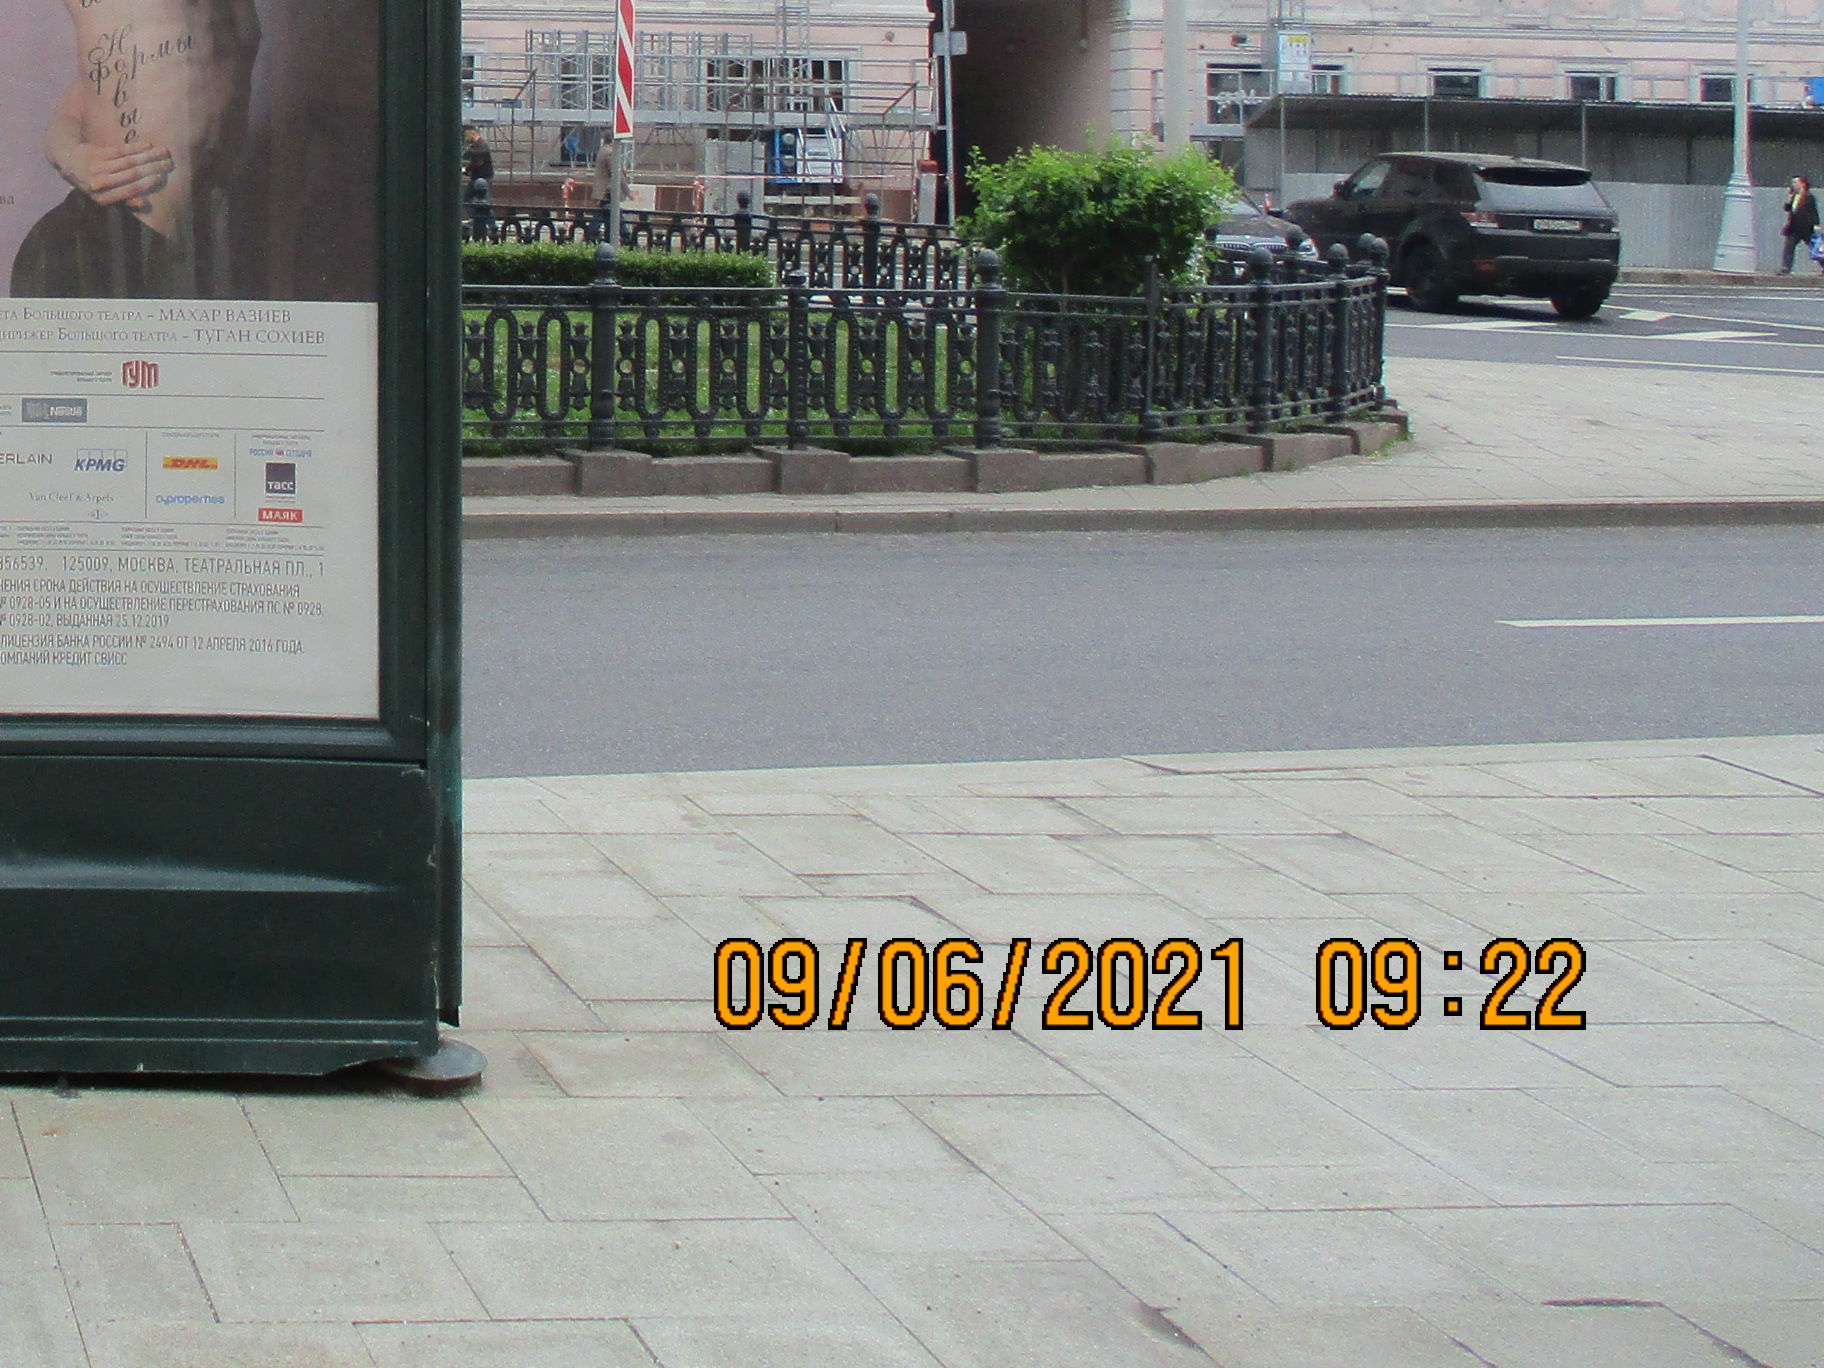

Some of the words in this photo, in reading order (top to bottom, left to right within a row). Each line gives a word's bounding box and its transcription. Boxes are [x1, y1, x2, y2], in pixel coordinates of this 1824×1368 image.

[98, 310, 143, 322] ТЕАТРА
[159, 308, 222, 323] МАХАР
[225, 308, 292, 324] ВАЗИЕВ
[193, 328, 251, 345] ТУГАН
[255, 328, 325, 345] СОХИЕВ
[121, 359, 161, 390] ГУМ
[74, 458, 127, 472] KPMG
[171, 458, 210, 470] DHL
[262, 509, 298, 521] МАЯК
[62, 556, 113, 573] 125009,
[118, 556, 179, 574] МОСКВА,
[184, 558, 281, 575] ТЕАТРАЛЬНАЯ
[318, 562, 324, 577] 1
[33, 579, 66, 593] СРОКА
[68, 579, 121, 595] ДЕЙСТВИЯ
[140, 580, 227, 595] ОСУЩЕСТВЛЕНИЕ
[229, 581, 300, 597] СТРАХОВАНИЯ
[79, 596, 167, 612] ОСУЩЕСТВЛЕНИЕ
[169, 598, 264, 614] ПЕРЕСТРАХОВАНИЯ
[56, 614, 113, 629] ВЫДАННАЯ
[0, 634, 55, 650] ЛИЦЕНЗИЯ
[56, 634, 90, 648] БАНКА
[92, 634, 133, 648] РОССИИ
[192, 636, 204, 650] 12
[206, 637, 246, 652] АПРЕЛЯ
[248, 638, 273, 652] 2016
[52, 651, 92, 667] КРЕДИТ
[94, 652, 128, 666] СВИСС
